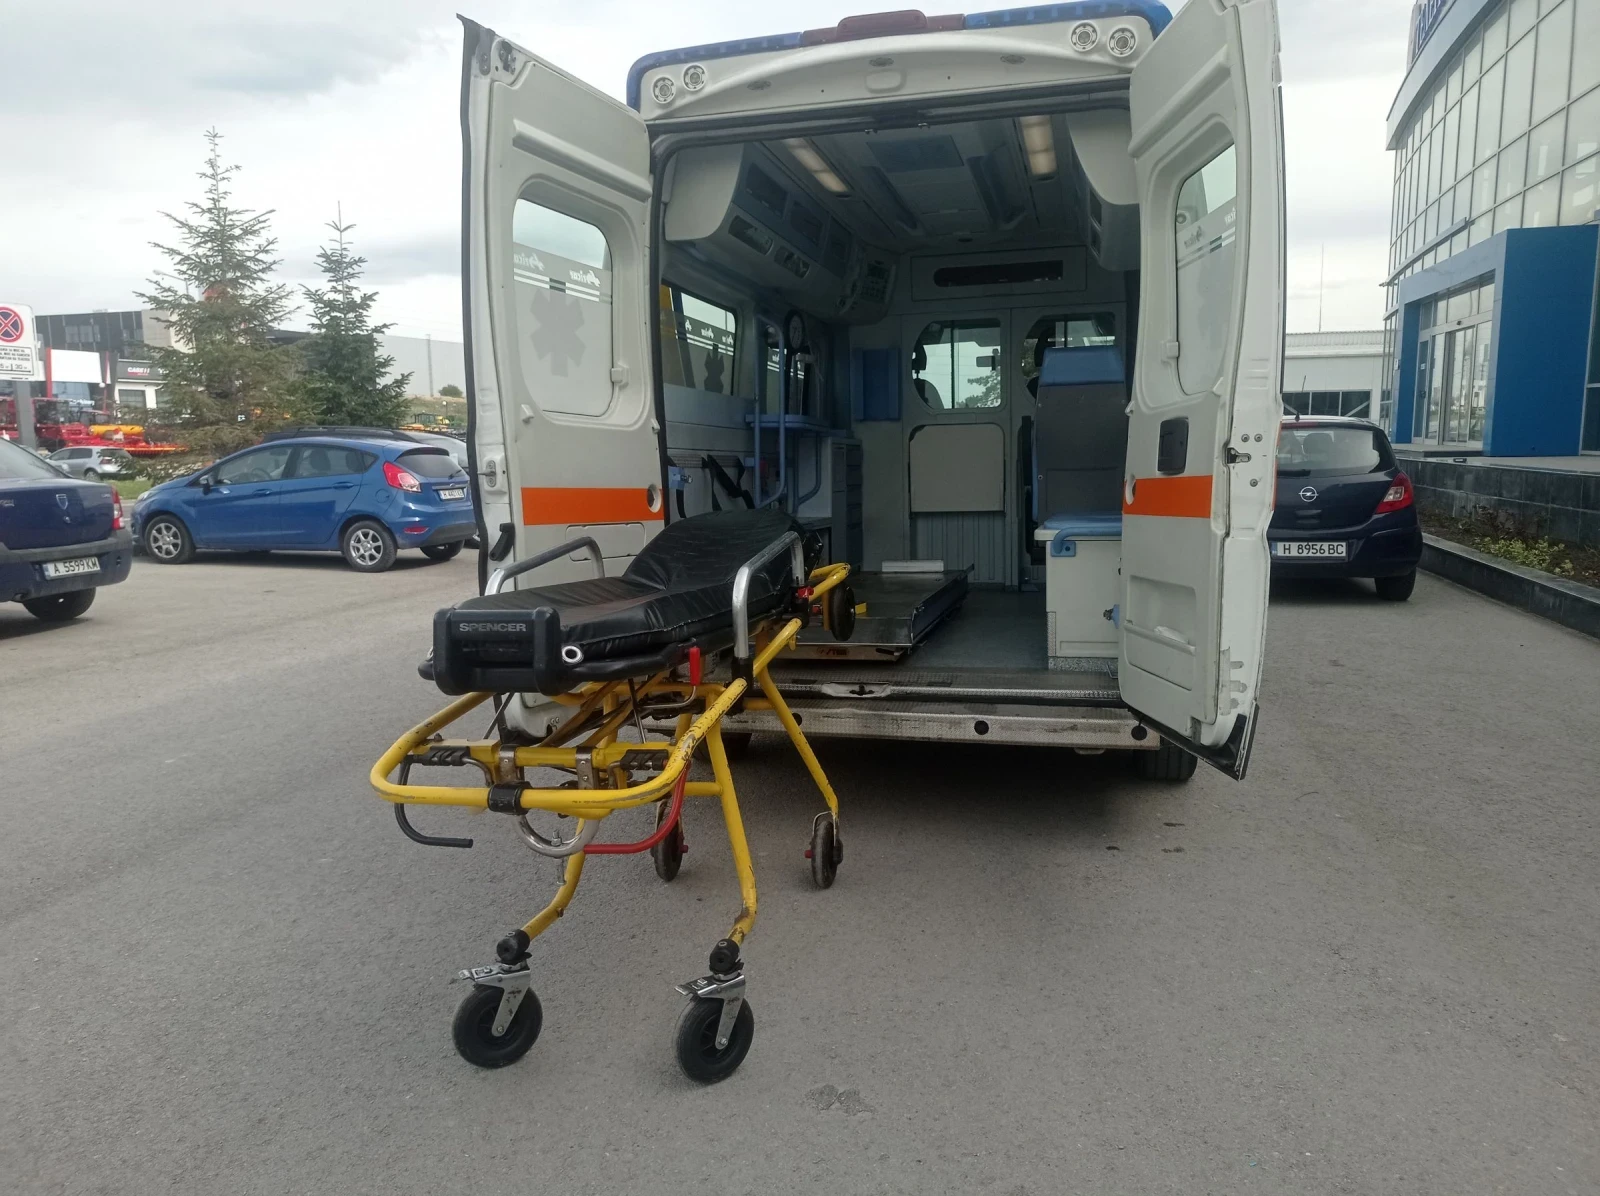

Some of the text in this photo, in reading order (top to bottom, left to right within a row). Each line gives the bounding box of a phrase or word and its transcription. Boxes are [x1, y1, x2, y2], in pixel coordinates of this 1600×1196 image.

[1283, 543, 1291, 555] H
[1297, 543, 1326, 555] 8956
[459, 622, 527, 632] SPENCER
